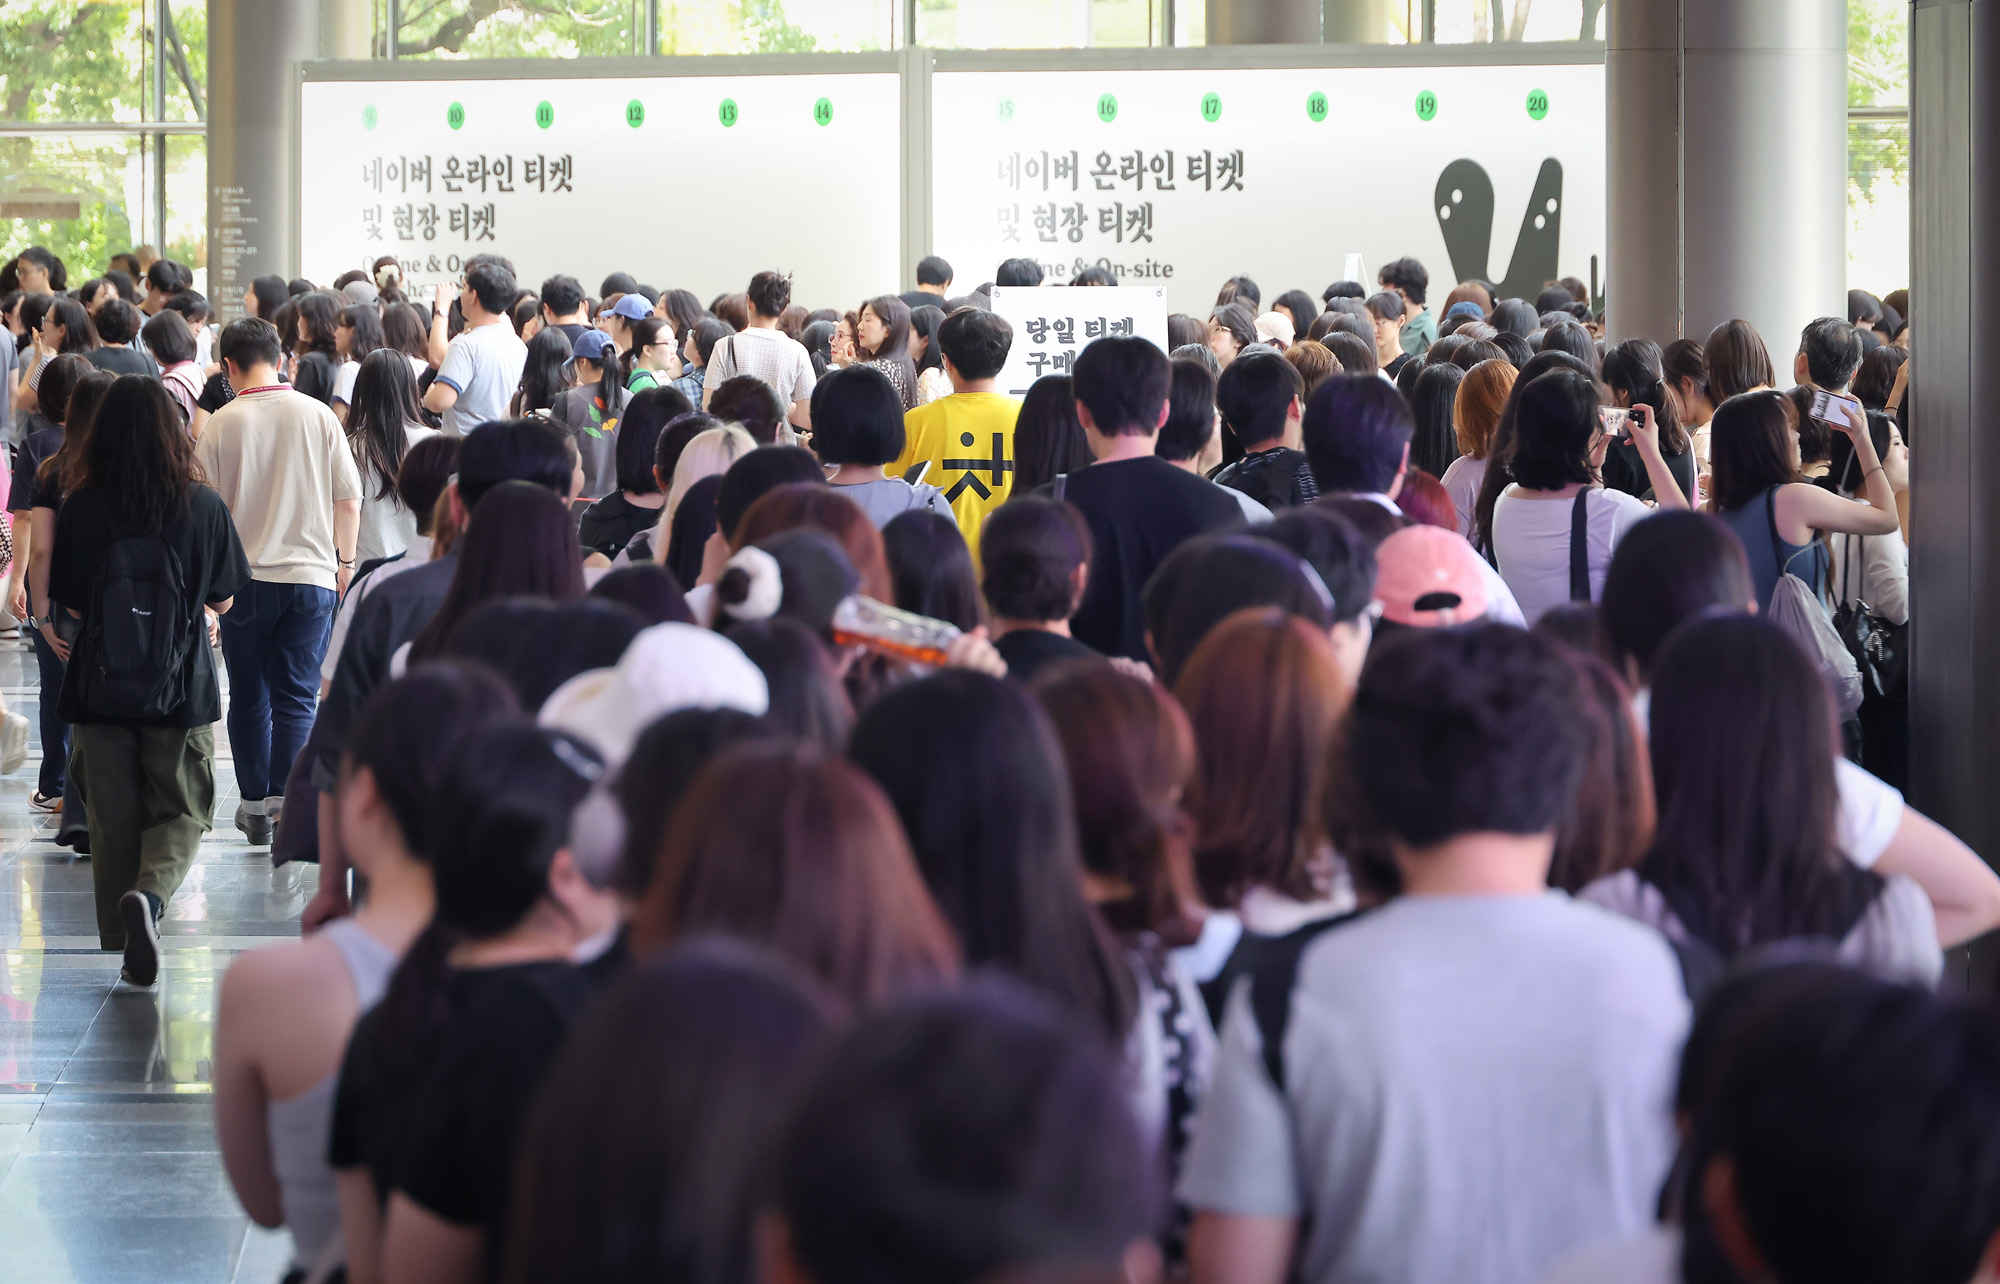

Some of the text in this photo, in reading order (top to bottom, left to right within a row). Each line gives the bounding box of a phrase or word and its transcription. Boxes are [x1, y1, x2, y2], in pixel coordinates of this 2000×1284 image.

[817, 104, 830, 119] 14
[999, 101, 1013, 117] 15
[1100, 100, 1115, 115] 16
[1204, 99, 1218, 114] 17
[1310, 98, 1325, 114] 18
[1419, 97, 1435, 113] 19
[1529, 96, 1547, 111] 20
[450, 108, 462, 122] 10
[540, 107, 550, 122] 11
[629, 106, 642, 121] 12
[722, 105, 735, 120] 13
[362, 154, 573, 193] 네이버 온라인 티켓
[997, 149, 1244, 192] 네이버 온라인 티켓
[362, 202, 496, 241] 및 현장 티켓
[997, 201, 1153, 244] 및 현장 티켓
[426, 254, 441, 273] &
[1025, 317, 1076, 344] 당일
[1026, 349, 1076, 378] 구매
